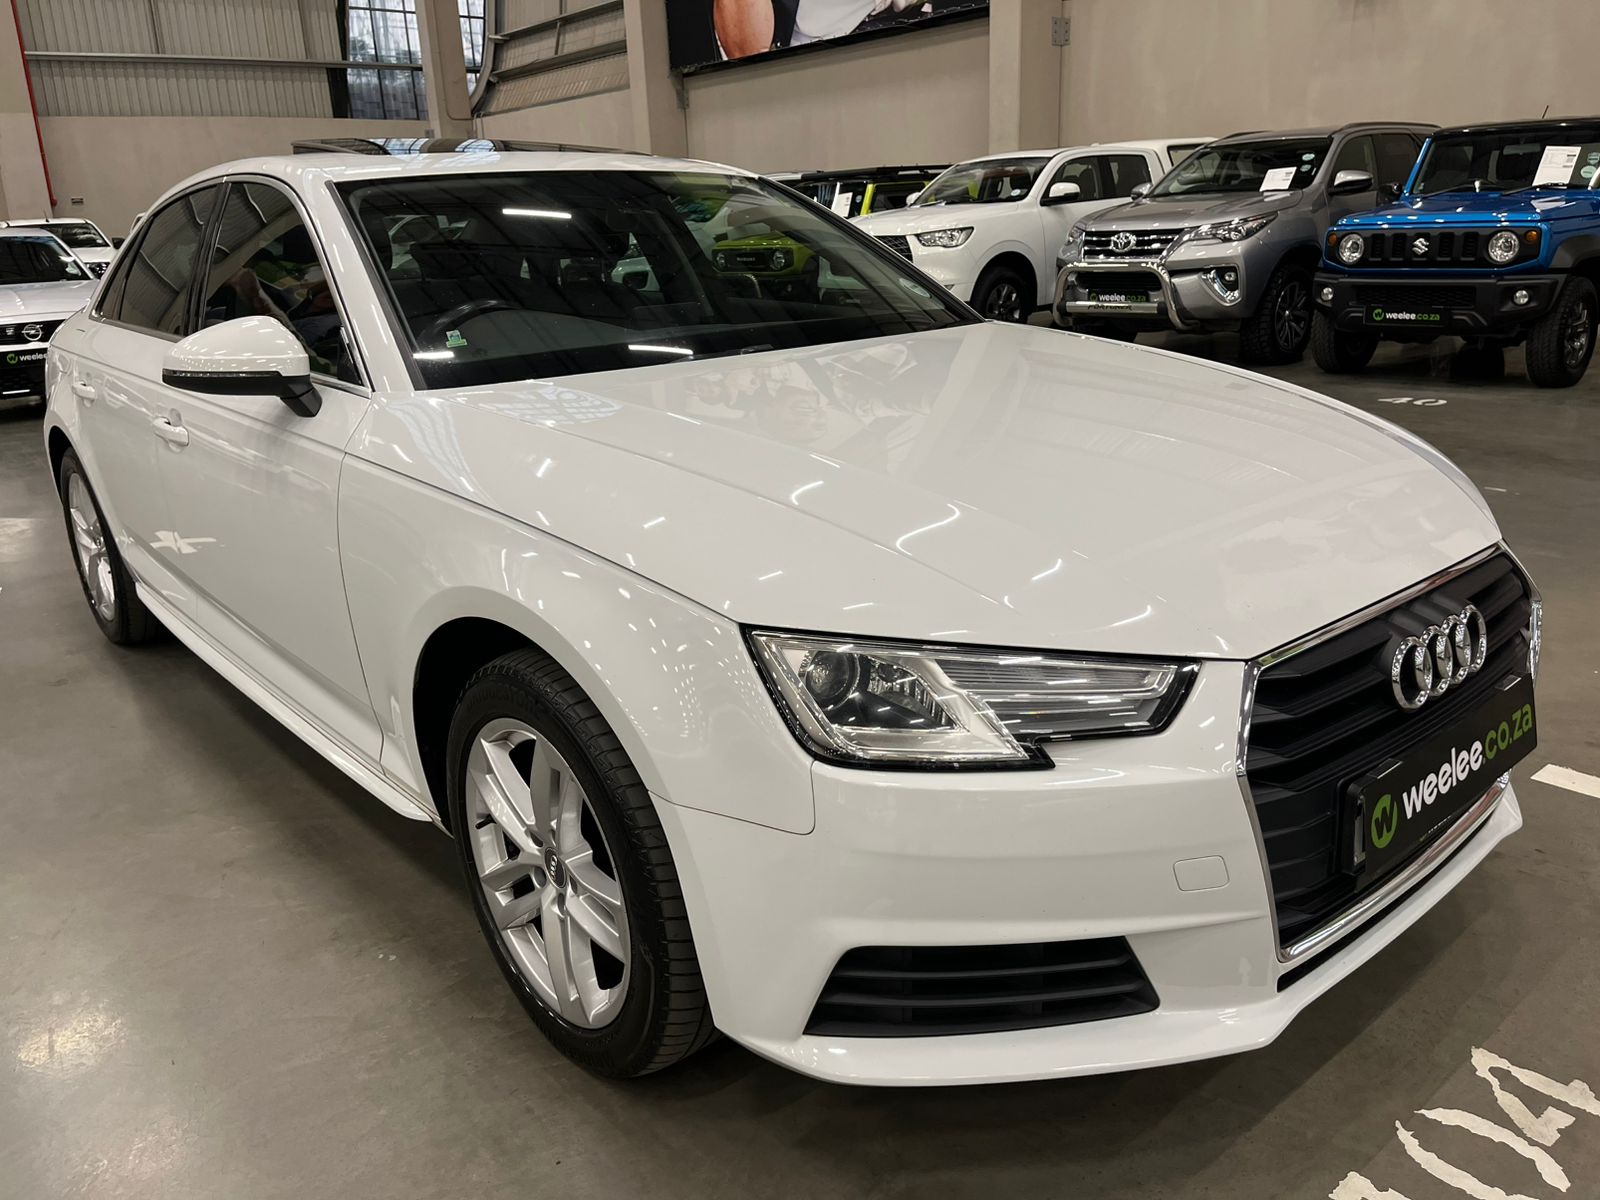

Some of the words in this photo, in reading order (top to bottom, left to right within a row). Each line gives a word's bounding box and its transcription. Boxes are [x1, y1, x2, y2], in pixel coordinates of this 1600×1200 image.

[1385, 311, 1440, 321] weelee.co.za
[1377, 397, 1448, 406] 40
[1402, 703, 1533, 820] weelee.co.za
[1328, 1046, 1600, 1200] 04
